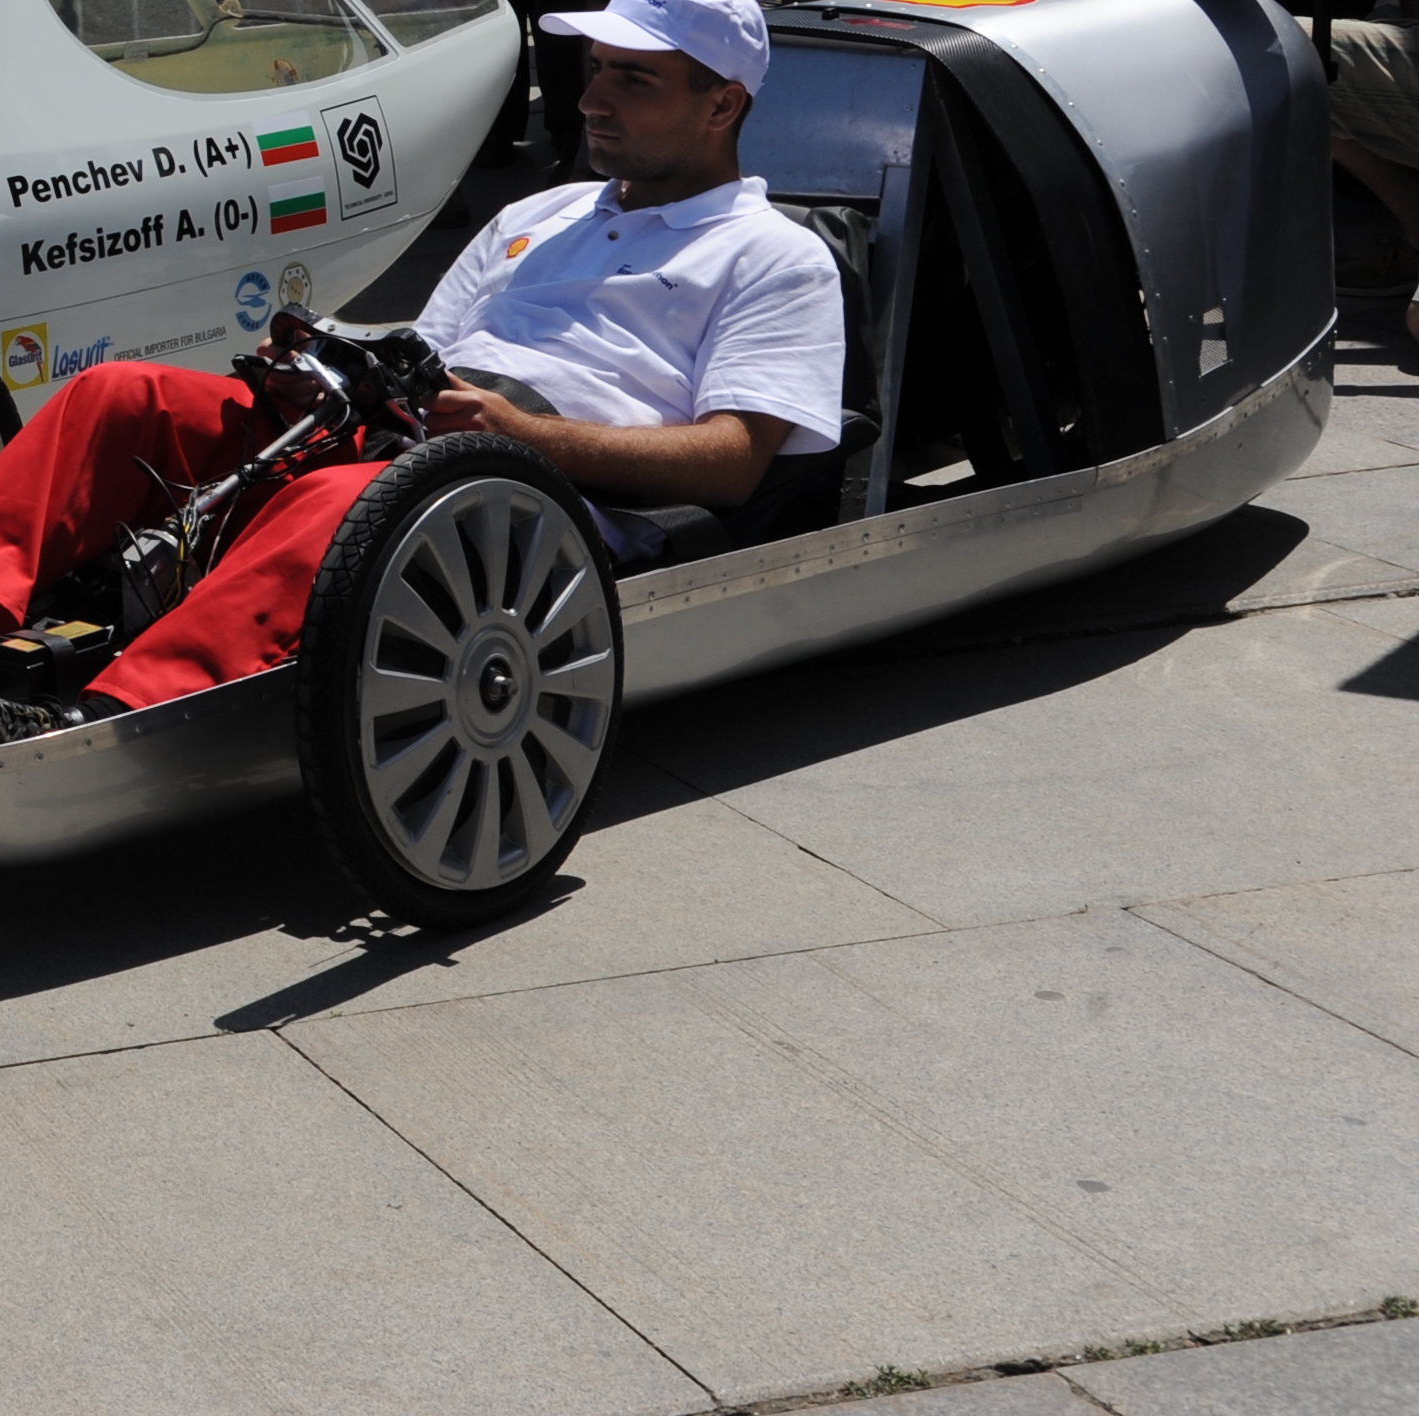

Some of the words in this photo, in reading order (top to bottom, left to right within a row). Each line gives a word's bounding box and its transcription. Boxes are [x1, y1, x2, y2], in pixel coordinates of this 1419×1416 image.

[7, 159, 144, 208] Penchev
[152, 147, 186, 179] D.
[193, 131, 252, 178] (A+)
[21, 214, 164, 276] Kefsizoff
[176, 208, 205, 243] A.
[145, 337, 180, 356] IMPORTER
[180, 334, 195, 347] FOR
[195, 325, 228, 344] BULGARIA
